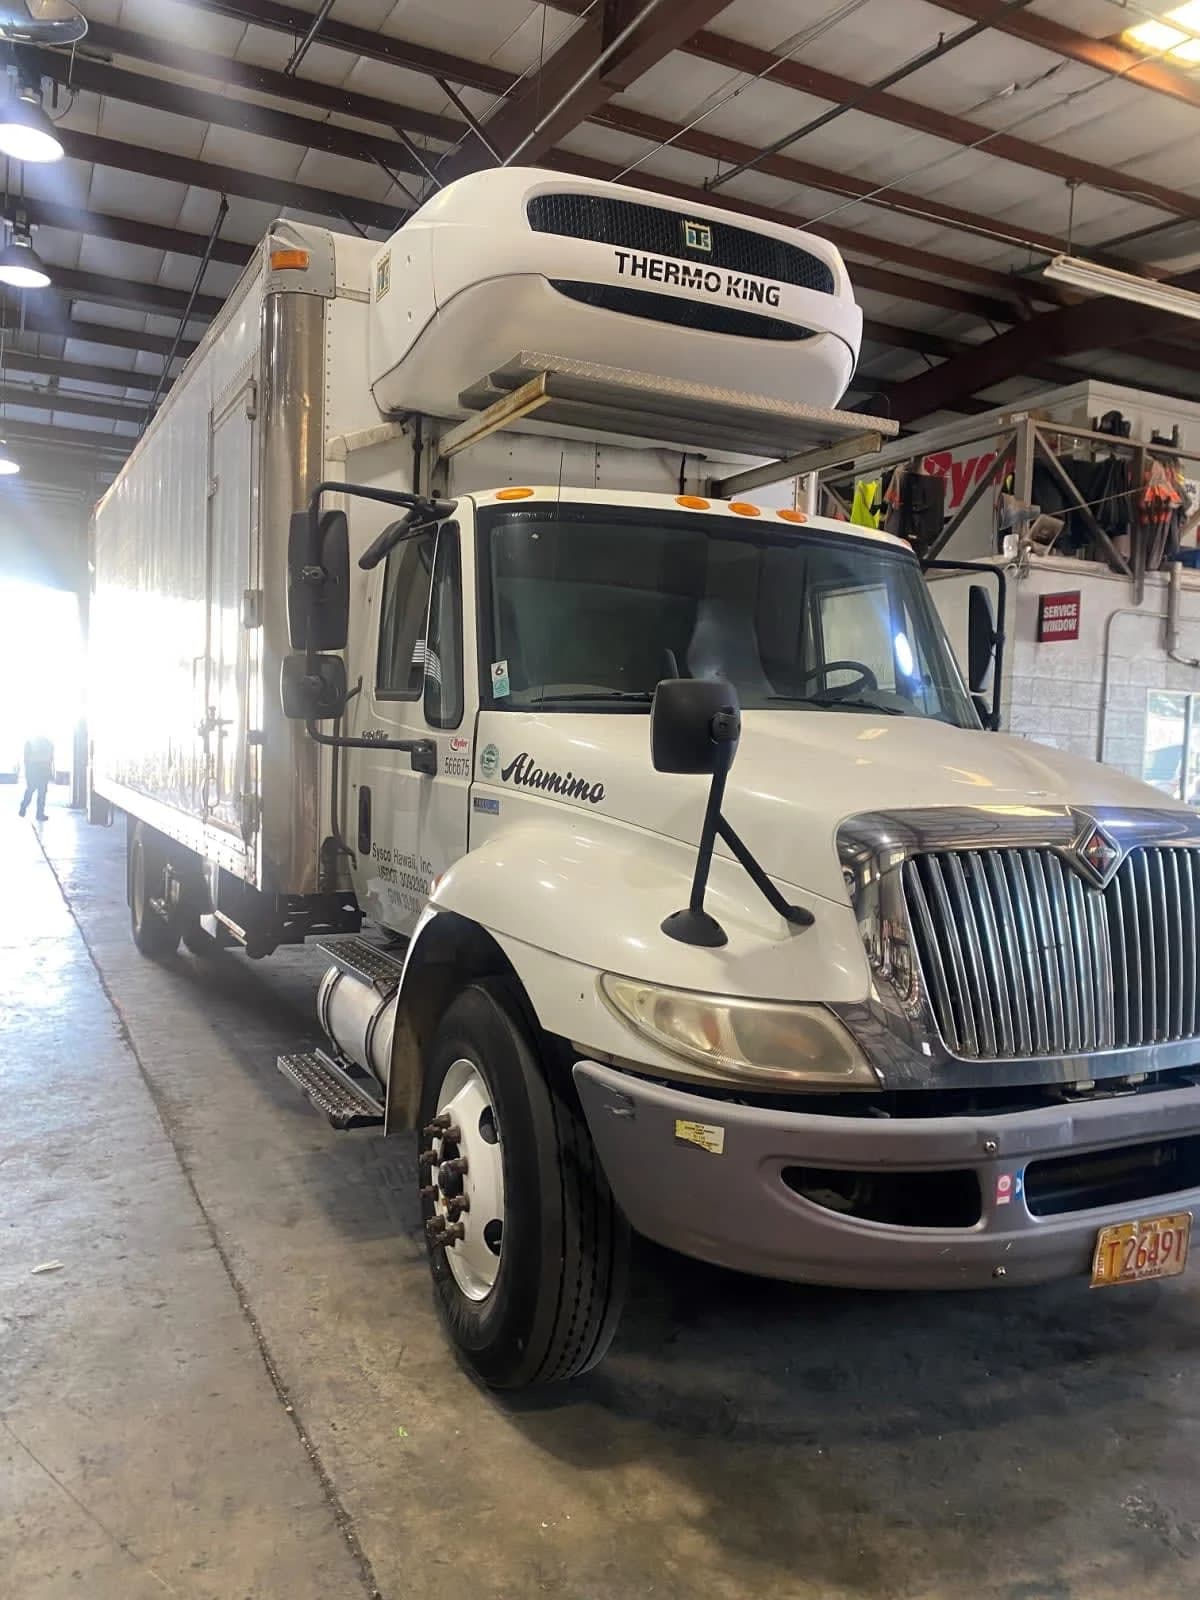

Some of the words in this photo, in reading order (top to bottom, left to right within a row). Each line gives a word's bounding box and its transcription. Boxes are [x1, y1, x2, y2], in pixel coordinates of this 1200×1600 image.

[614, 250, 722, 293] THERMO
[726, 275, 780, 307] KING
[1043, 603, 1078, 618] SERVICE
[1042, 618, 1078, 633] WINDOW
[444, 756, 470, 777] 566675
[501, 752, 606, 804] Alamimo
[372, 842, 391, 862] Sysco
[420, 856, 434, 876] Inc.
